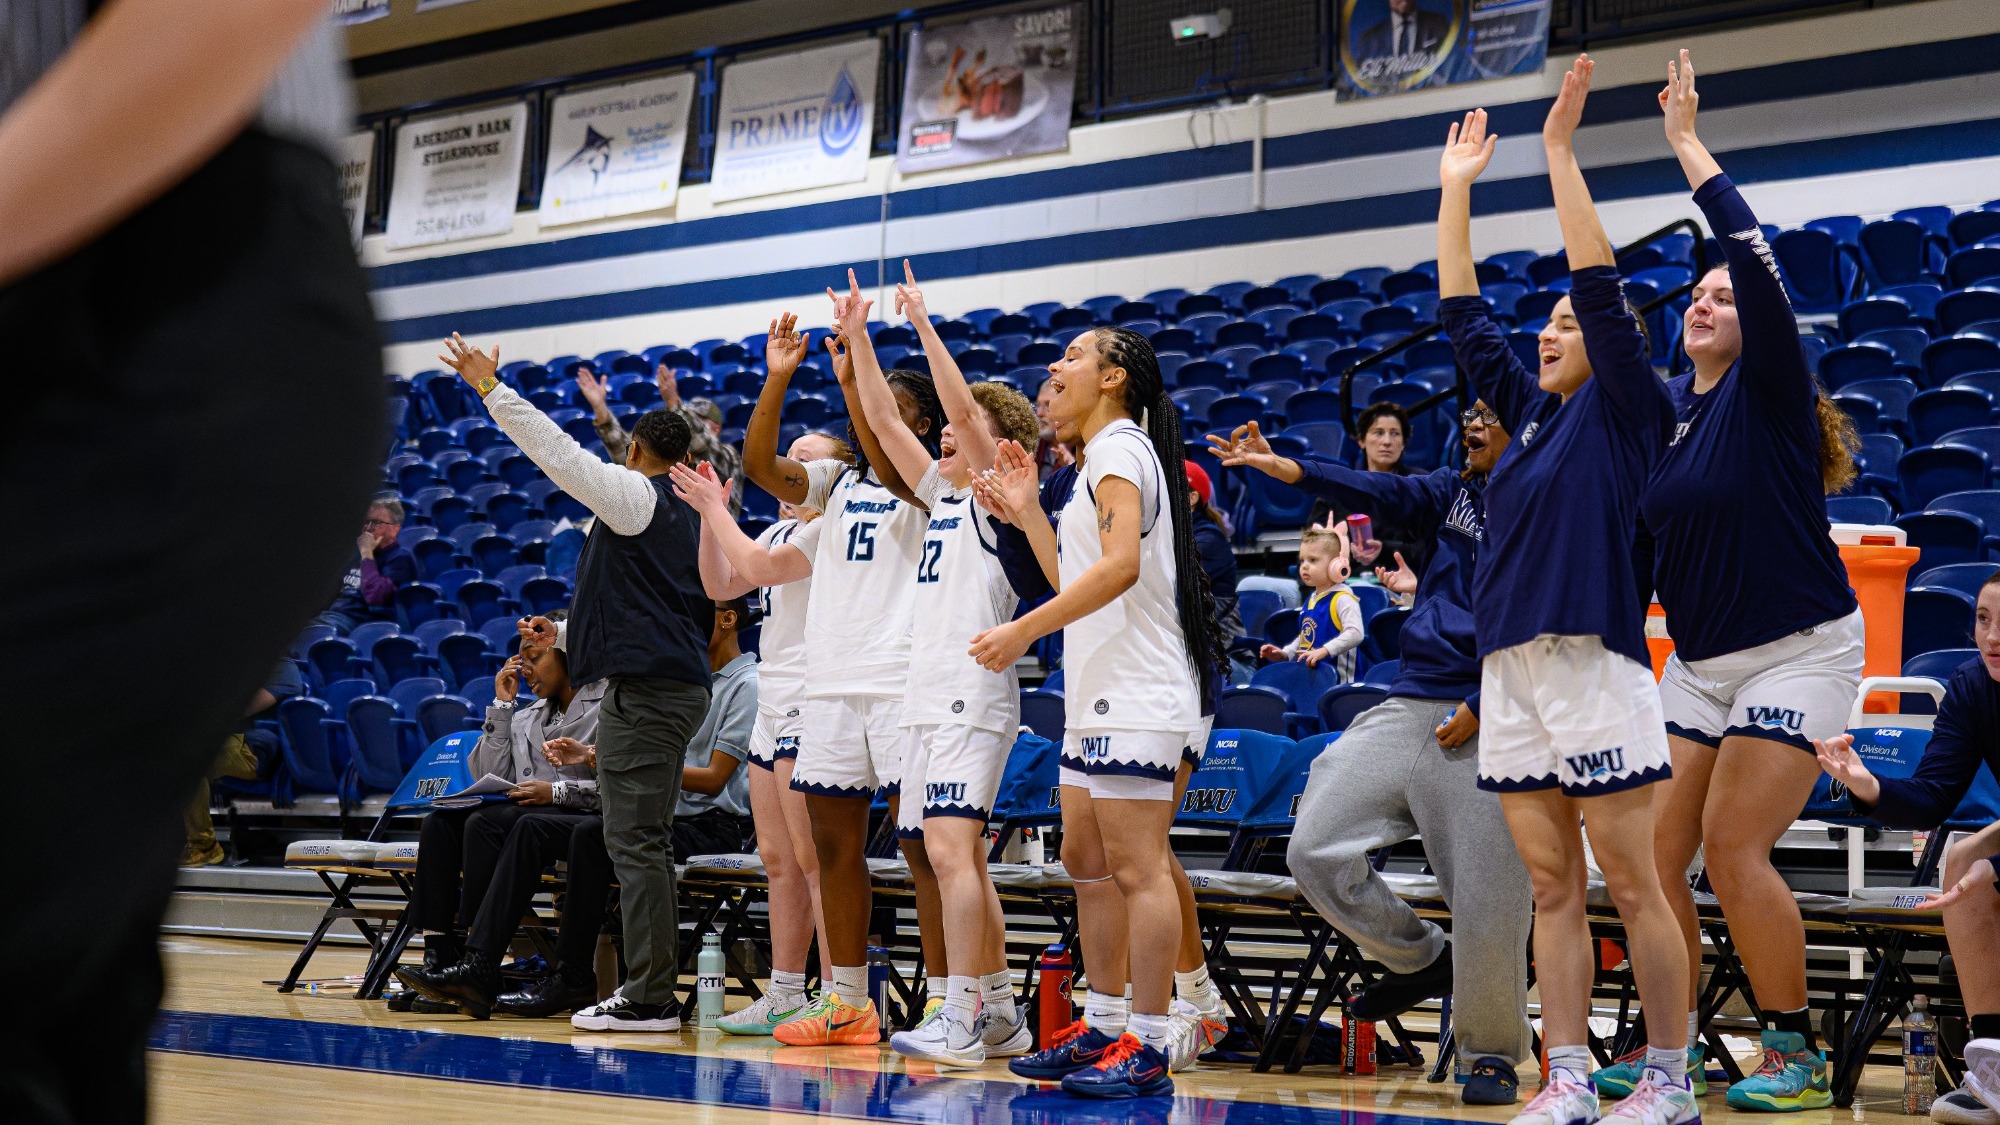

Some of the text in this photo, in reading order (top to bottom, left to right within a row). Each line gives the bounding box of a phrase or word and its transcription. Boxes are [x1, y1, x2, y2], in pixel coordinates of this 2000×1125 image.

[476, 118, 511, 137] BARN
[728, 105, 819, 150] PRIME
[421, 141, 499, 166] STEAKHOUSE
[846, 521, 878, 561] 15
[917, 539, 943, 583] 22
[1746, 706, 1805, 731] VWU
[1216, 740, 1239, 749] NCAA
[1875, 728, 1903, 738] NCAA
[1205, 757, 1230, 766] Division
[1565, 746, 1626, 778] VWU
[1860, 744, 1890, 756] Division
[926, 782, 967, 802] VWU
[1182, 788, 1238, 814] VWU
